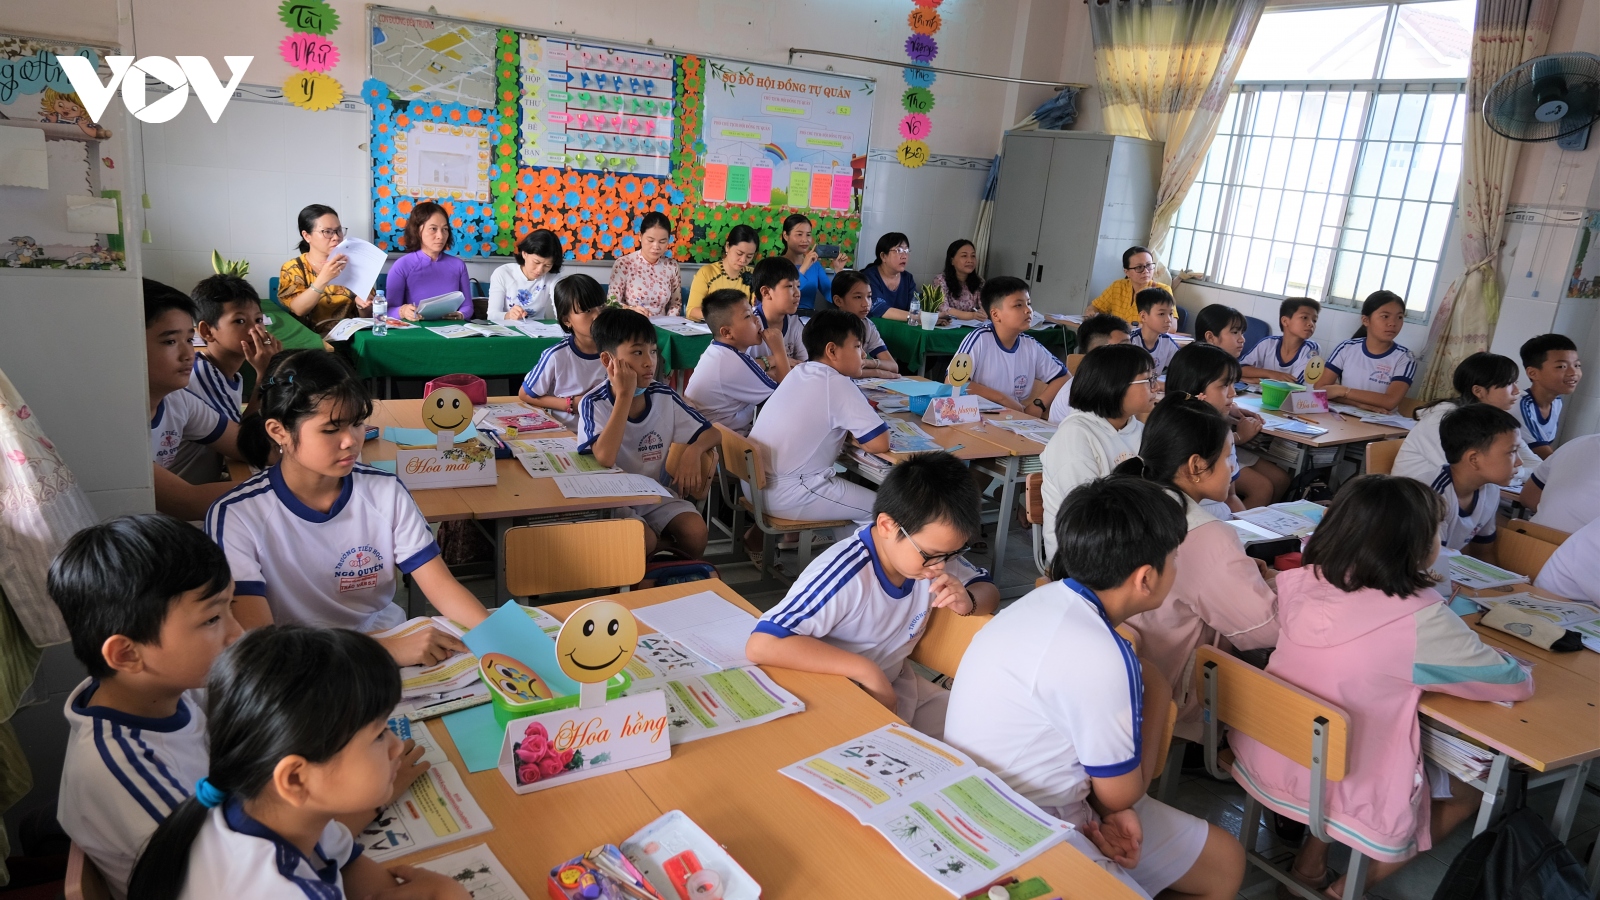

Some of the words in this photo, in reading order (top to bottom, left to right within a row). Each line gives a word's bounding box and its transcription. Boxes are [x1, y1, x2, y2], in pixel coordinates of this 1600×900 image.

[722, 72, 737, 83] SƠ
[738, 72, 755, 86] ĐỒ
[756, 76, 775, 90] HỘI
[777, 78, 807, 93] ĐỒNG
[808, 84, 823, 97] TỰ
[823, 86, 852, 99] QUẢN
[405, 456, 442, 475] Hoa
[445, 462, 470, 472] mai
[334, 570, 355, 578] NGÔ
[357, 563, 384, 577] QUYỀN
[553, 717, 612, 752] Hoa
[619, 711, 669, 744] hồng
